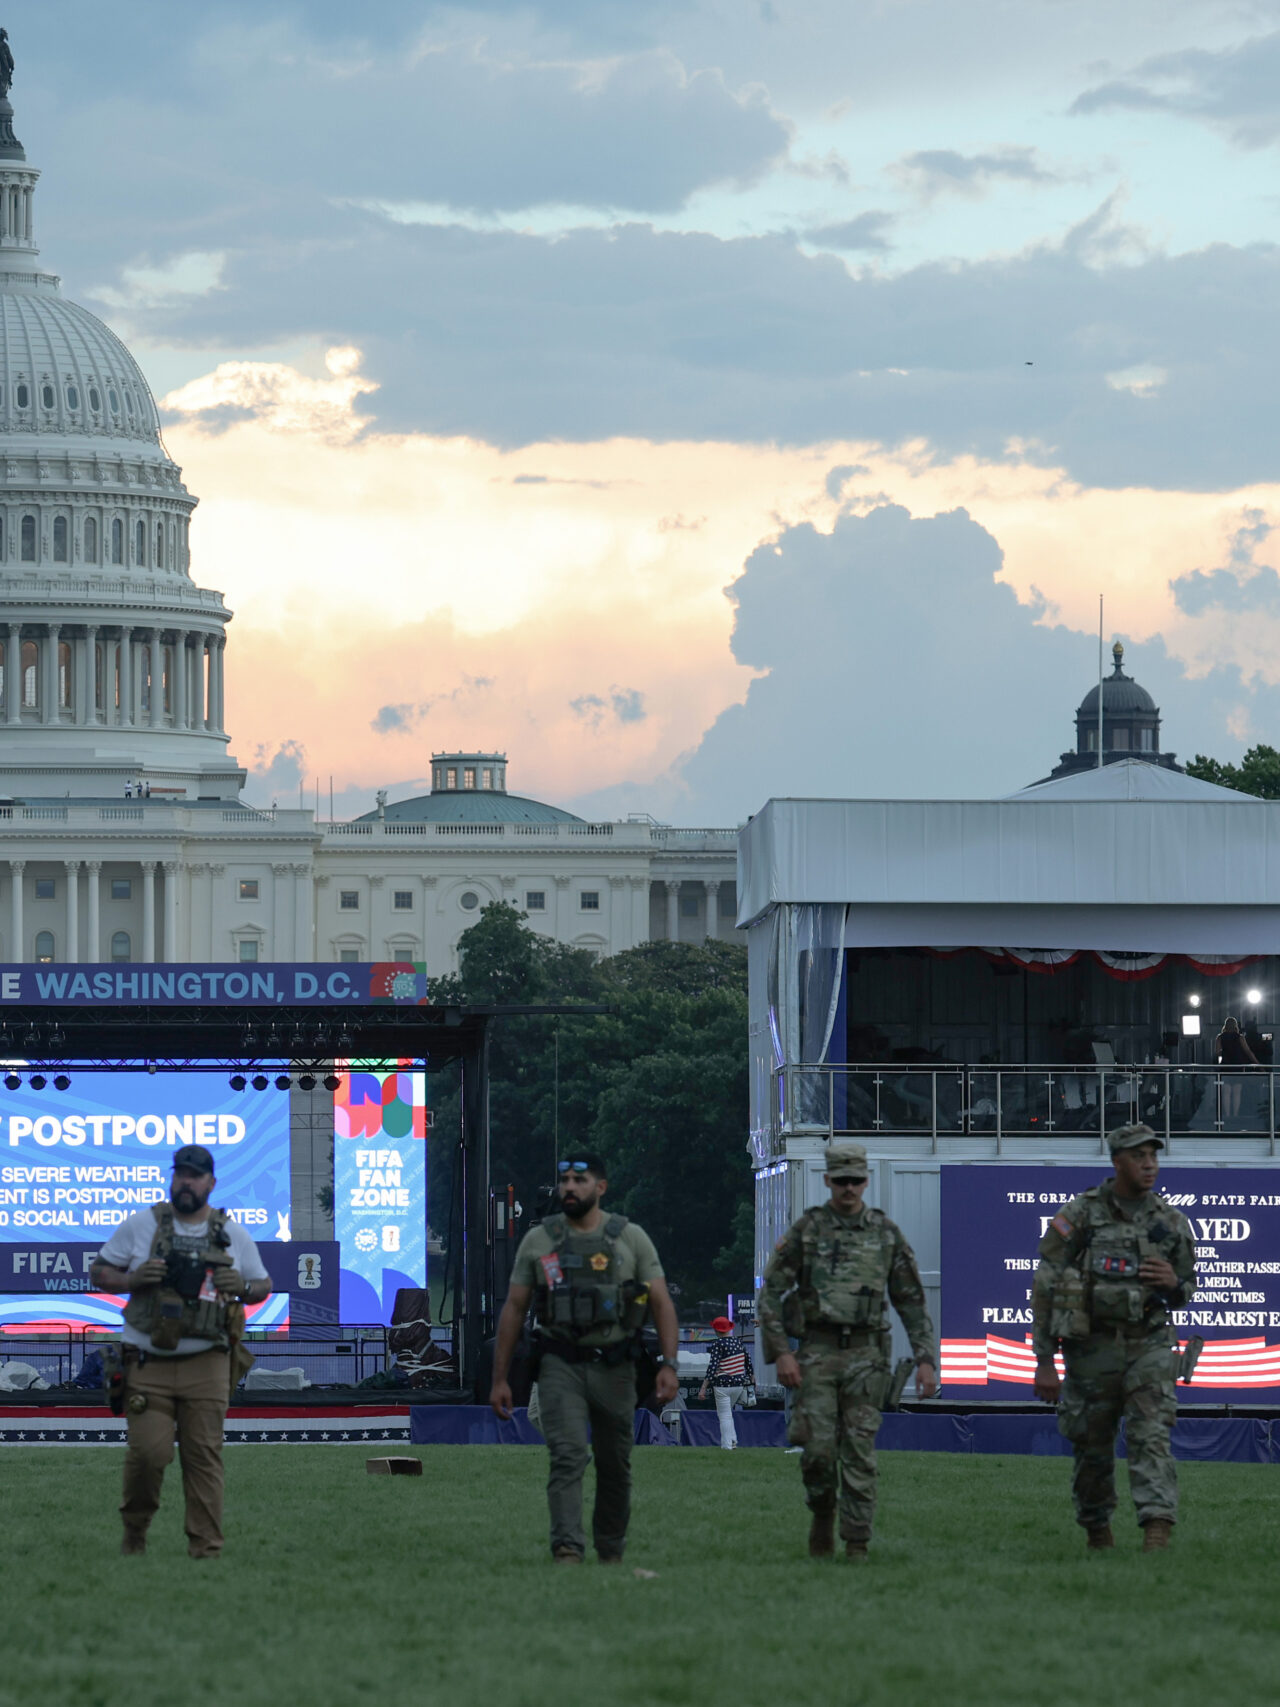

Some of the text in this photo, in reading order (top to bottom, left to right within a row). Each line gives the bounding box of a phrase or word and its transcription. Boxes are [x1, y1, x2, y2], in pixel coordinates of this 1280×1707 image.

[35, 972, 284, 1002] WASHINGTON,
[294, 972, 359, 999] D.C.
[9, 1114, 246, 1147] POSTPONED
[356, 1150, 404, 1168] FIFA
[1, 1167, 70, 1183] SEVERE
[75, 1166, 165, 1184] WEATHER,
[359, 1169, 401, 1187] FAN
[33, 1189, 49, 1204] IS
[55, 1188, 169, 1204] POSTPONED.
[350, 1189, 410, 1207] ZONE
[1007, 1193, 1035, 1203] THE
[1039, 1193, 1082, 1203] GREA
[1201, 1195, 1245, 1206] STATE
[1249, 1195, 1280, 1206] FAIR
[13, 1210, 80, 1226] SOCIAL
[226, 1208, 268, 1224] ATES
[1194, 1246, 1219, 1259] HER,
[13, 1252, 73, 1274] FIFA
[1004, 1259, 1031, 1270] THIS
[1247, 1262, 1280, 1274] PASSE
[1204, 1276, 1242, 1288] MEDIA
[737, 1299, 750, 1308] FIFA
[1189, 1292, 1265, 1304] ENING TIMES
[982, 1307, 1034, 1323] PLEAS
[1189, 1311, 1267, 1327] NEAREST
